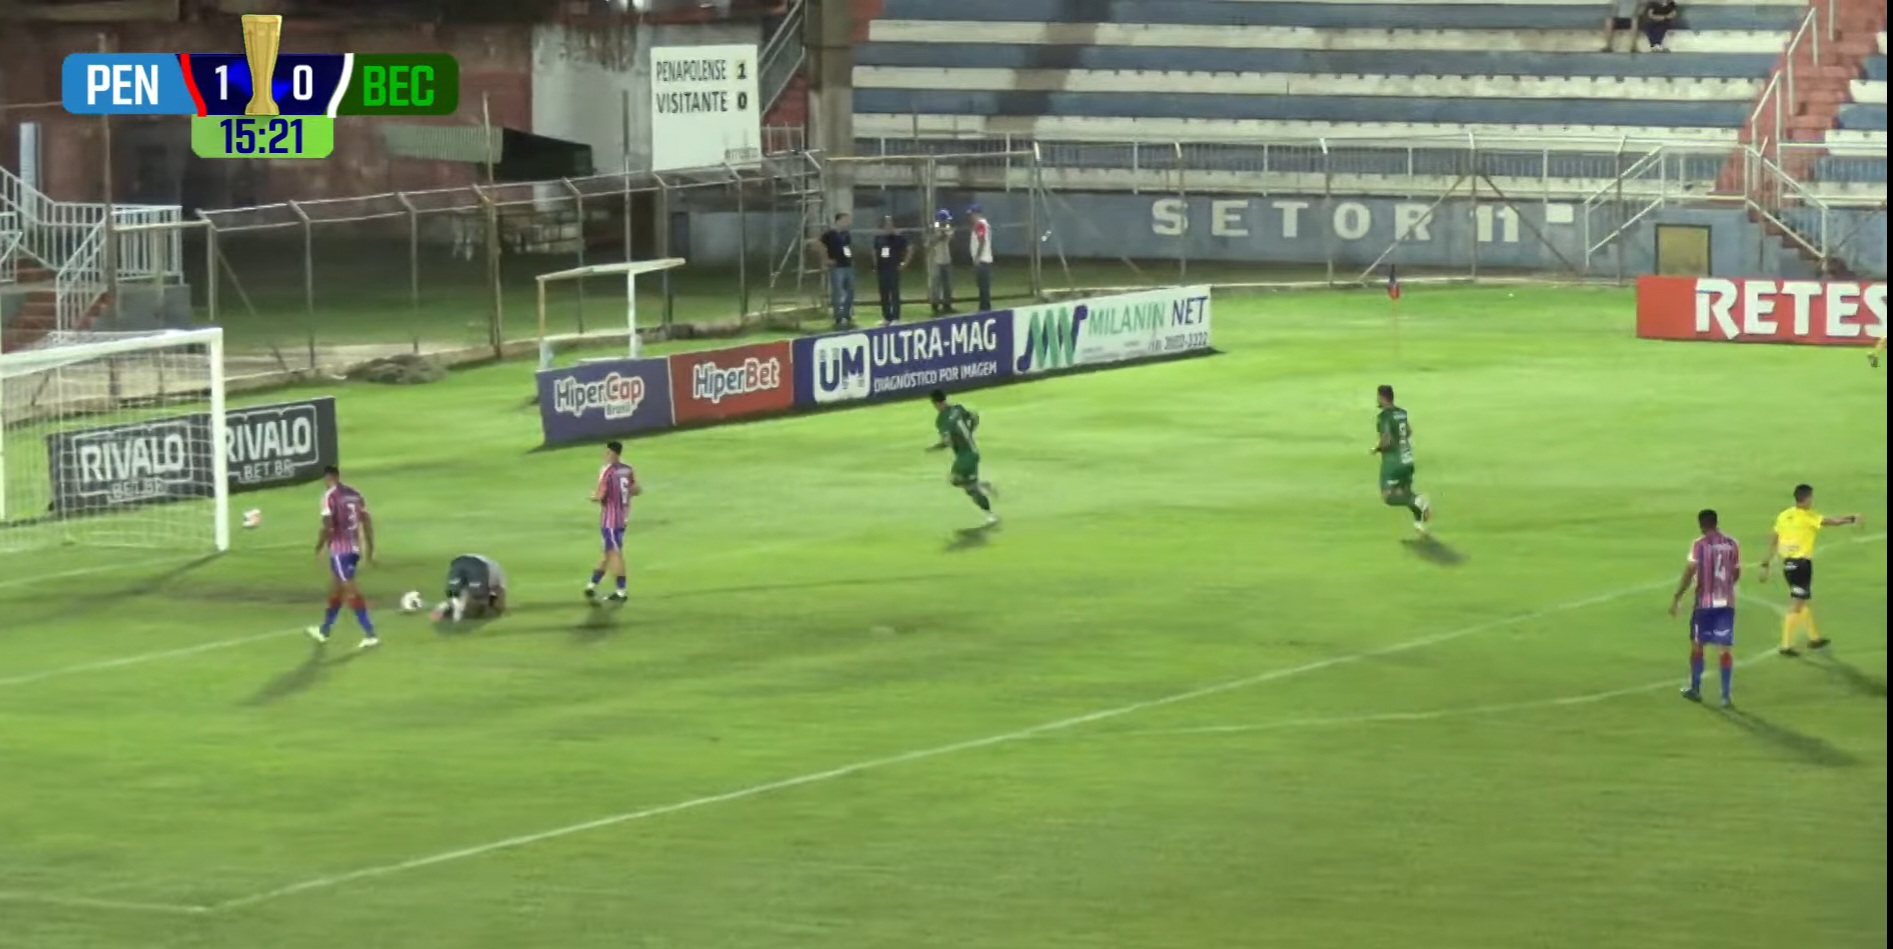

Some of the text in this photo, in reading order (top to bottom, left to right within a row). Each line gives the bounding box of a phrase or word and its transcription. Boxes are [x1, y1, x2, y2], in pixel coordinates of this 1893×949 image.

[656, 60, 747, 81] PENAPOLENSE 1
[656, 91, 748, 113] VISITANTE 0
[1151, 198, 1434, 242] SETOR
[1088, 295, 1209, 337] MILANIN NET
[873, 318, 997, 366] ULTRA-MAG
[694, 359, 779, 401] HiperBet
[939, 366, 959, 382] POR
[960, 360, 998, 380] IMAGEM
[555, 373, 643, 415] HiperCap
[80, 433, 184, 483] RIVALO
[1714, 553, 1726, 582] 4
